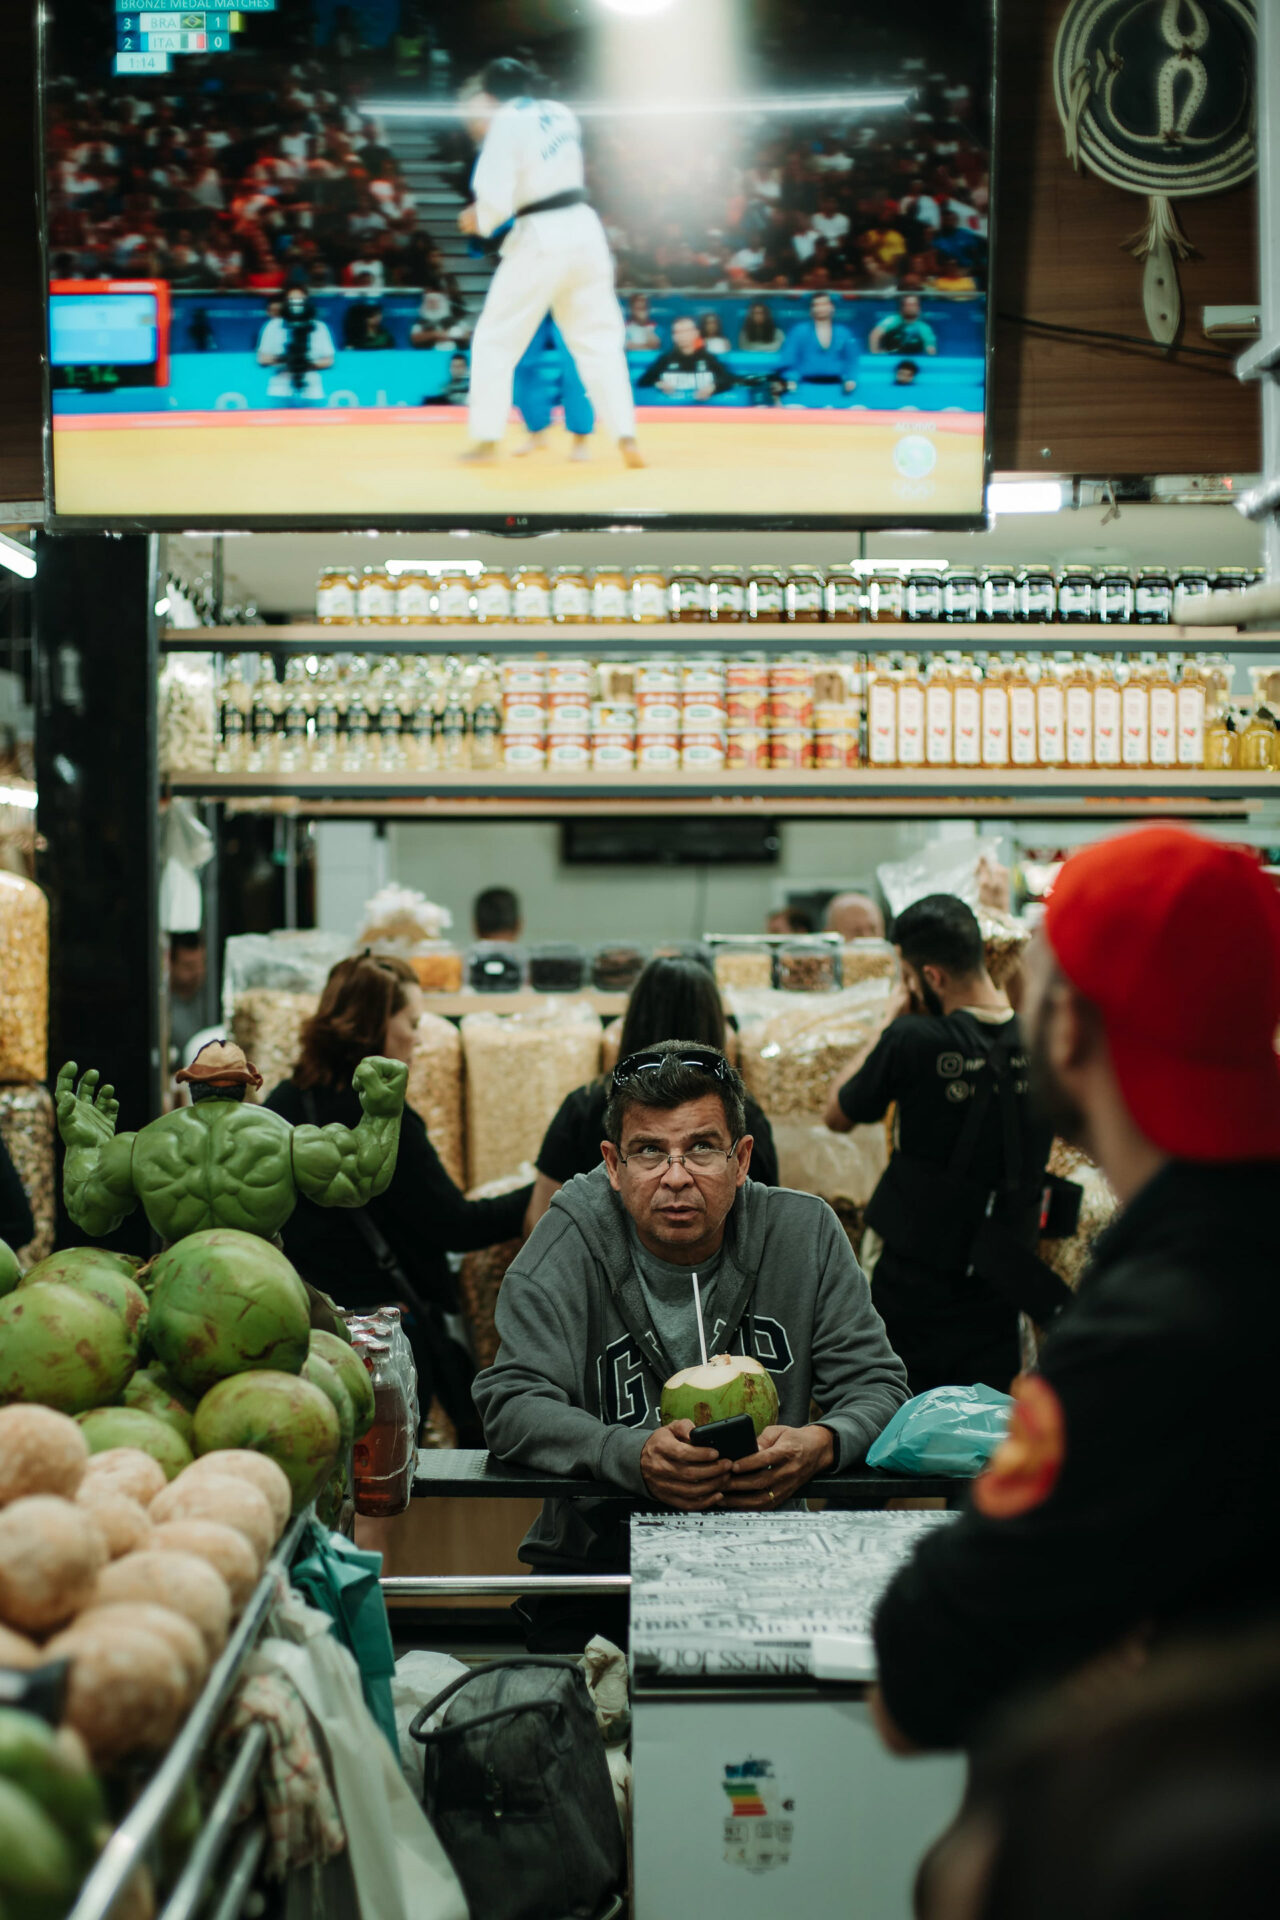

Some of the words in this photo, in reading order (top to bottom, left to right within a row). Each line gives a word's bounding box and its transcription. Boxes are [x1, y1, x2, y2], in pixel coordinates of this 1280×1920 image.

[121, 0, 167, 9] BRONZE
[172, 0, 211, 9] MEDAL
[214, 0, 270, 8] MATCHES
[123, 17, 132, 30] 3
[151, 17, 177, 29] BRA
[124, 37, 132, 49] 2
[153, 35, 175, 49] ITA
[214, 36, 222, 48] 0
[129, 57, 155, 69] 1:14
